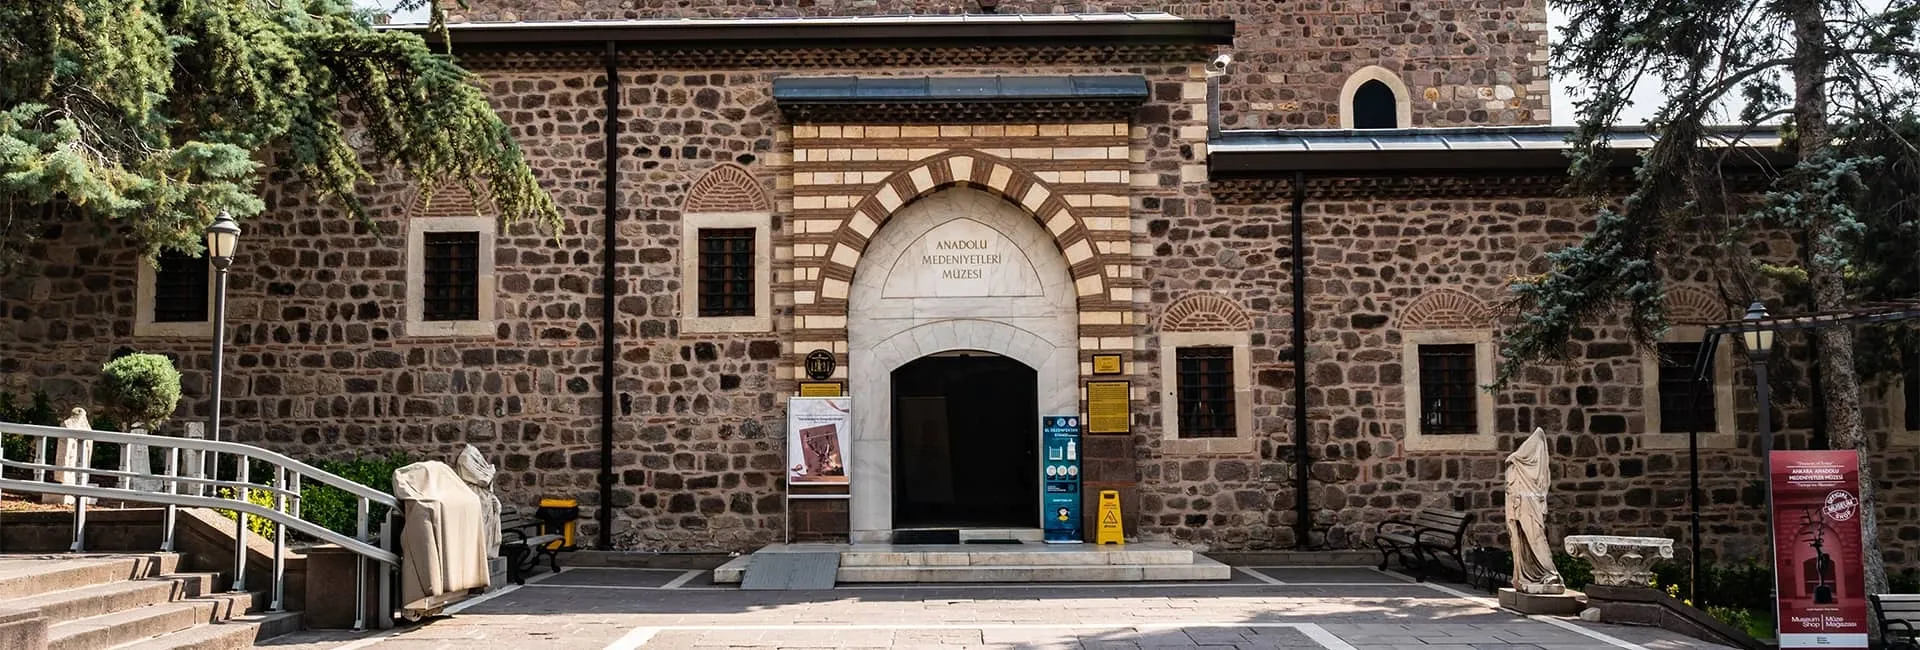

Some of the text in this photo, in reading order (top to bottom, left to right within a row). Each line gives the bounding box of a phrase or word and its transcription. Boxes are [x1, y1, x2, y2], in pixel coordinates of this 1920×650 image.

[936, 240, 987, 249] ANADOLU
[922, 253, 1001, 264] MEDENİYETLERİ
[942, 268, 982, 279] MÜZESİ
